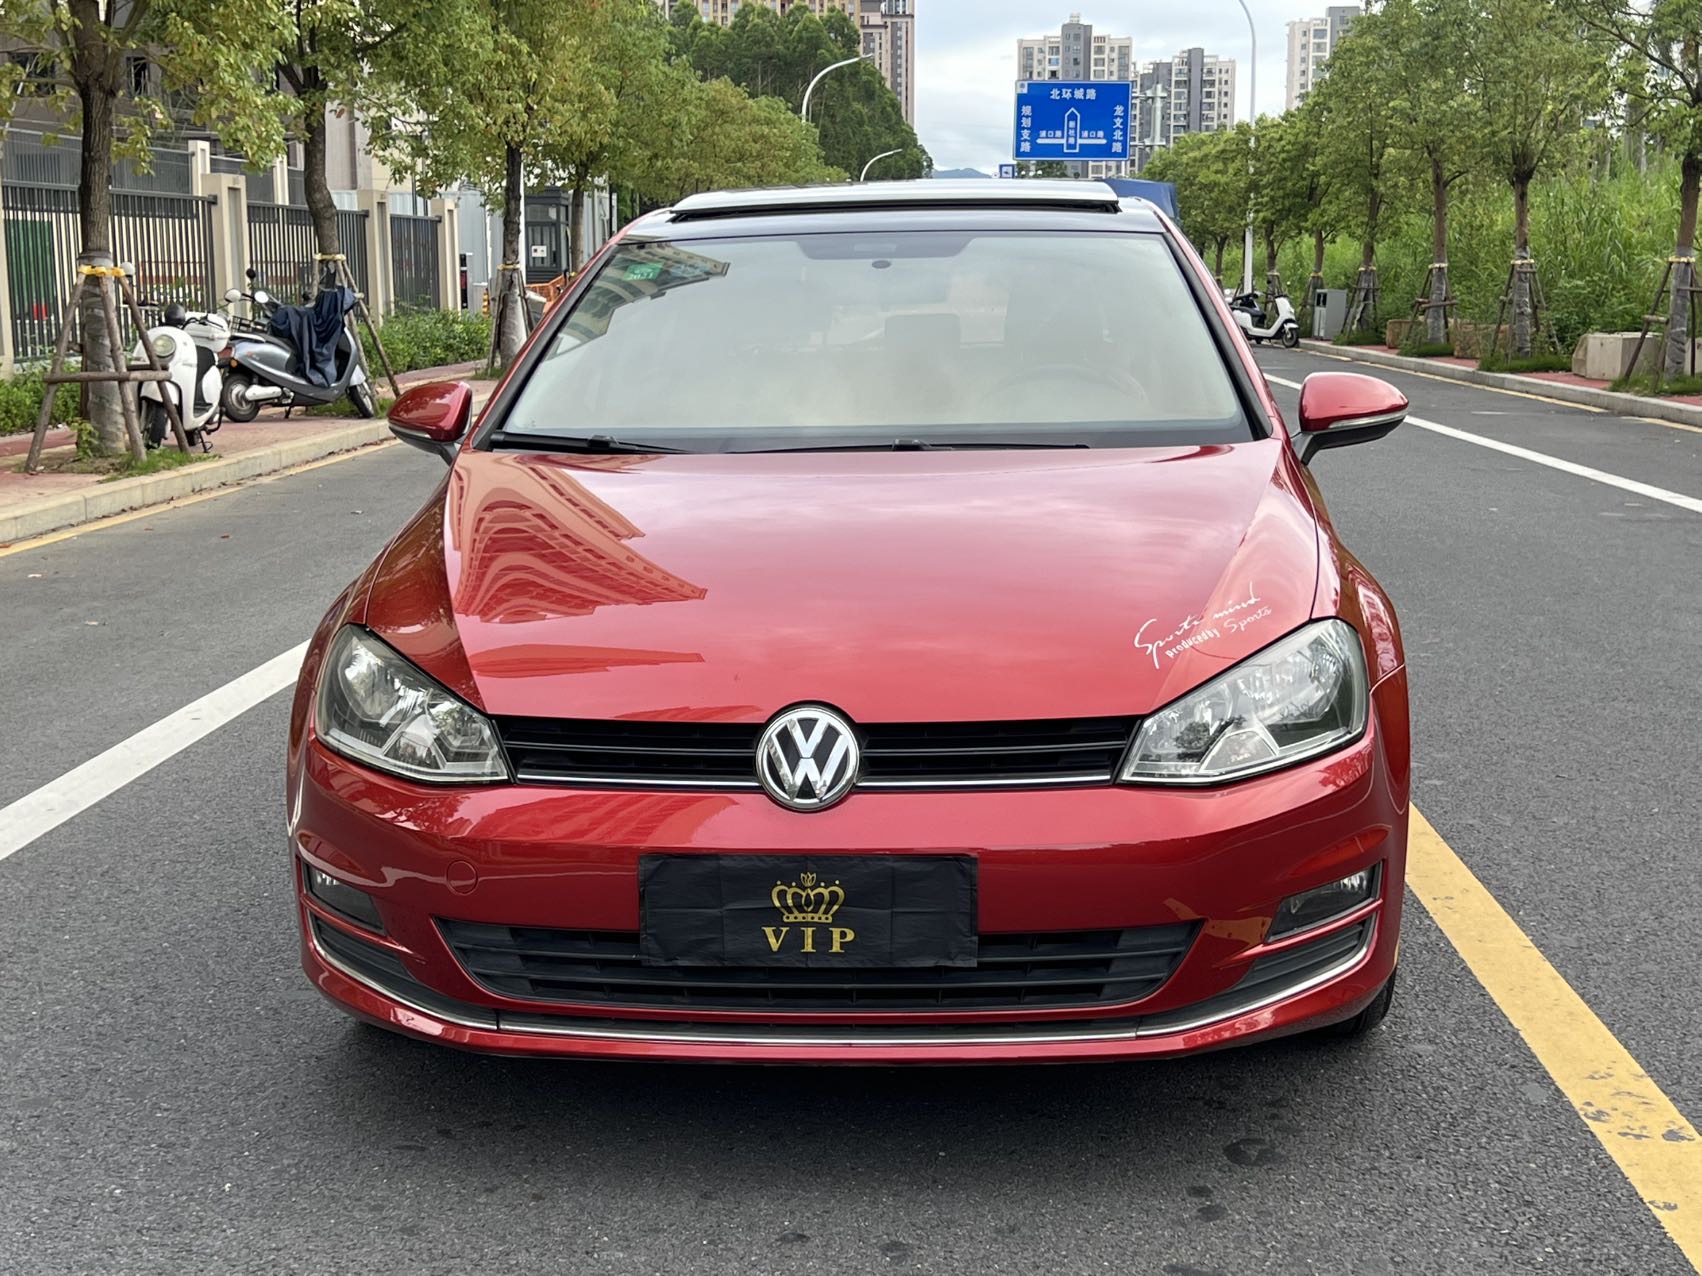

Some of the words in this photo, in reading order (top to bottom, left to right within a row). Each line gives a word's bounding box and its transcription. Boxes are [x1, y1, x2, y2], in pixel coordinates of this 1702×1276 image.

[1050, 88, 1097, 100] 北环城路
[1020, 105, 1032, 153] 规划支路
[1112, 105, 1125, 153] 龙文北路
[1223, 605, 1272, 633] Sports
[761, 926, 856, 953] VIP
